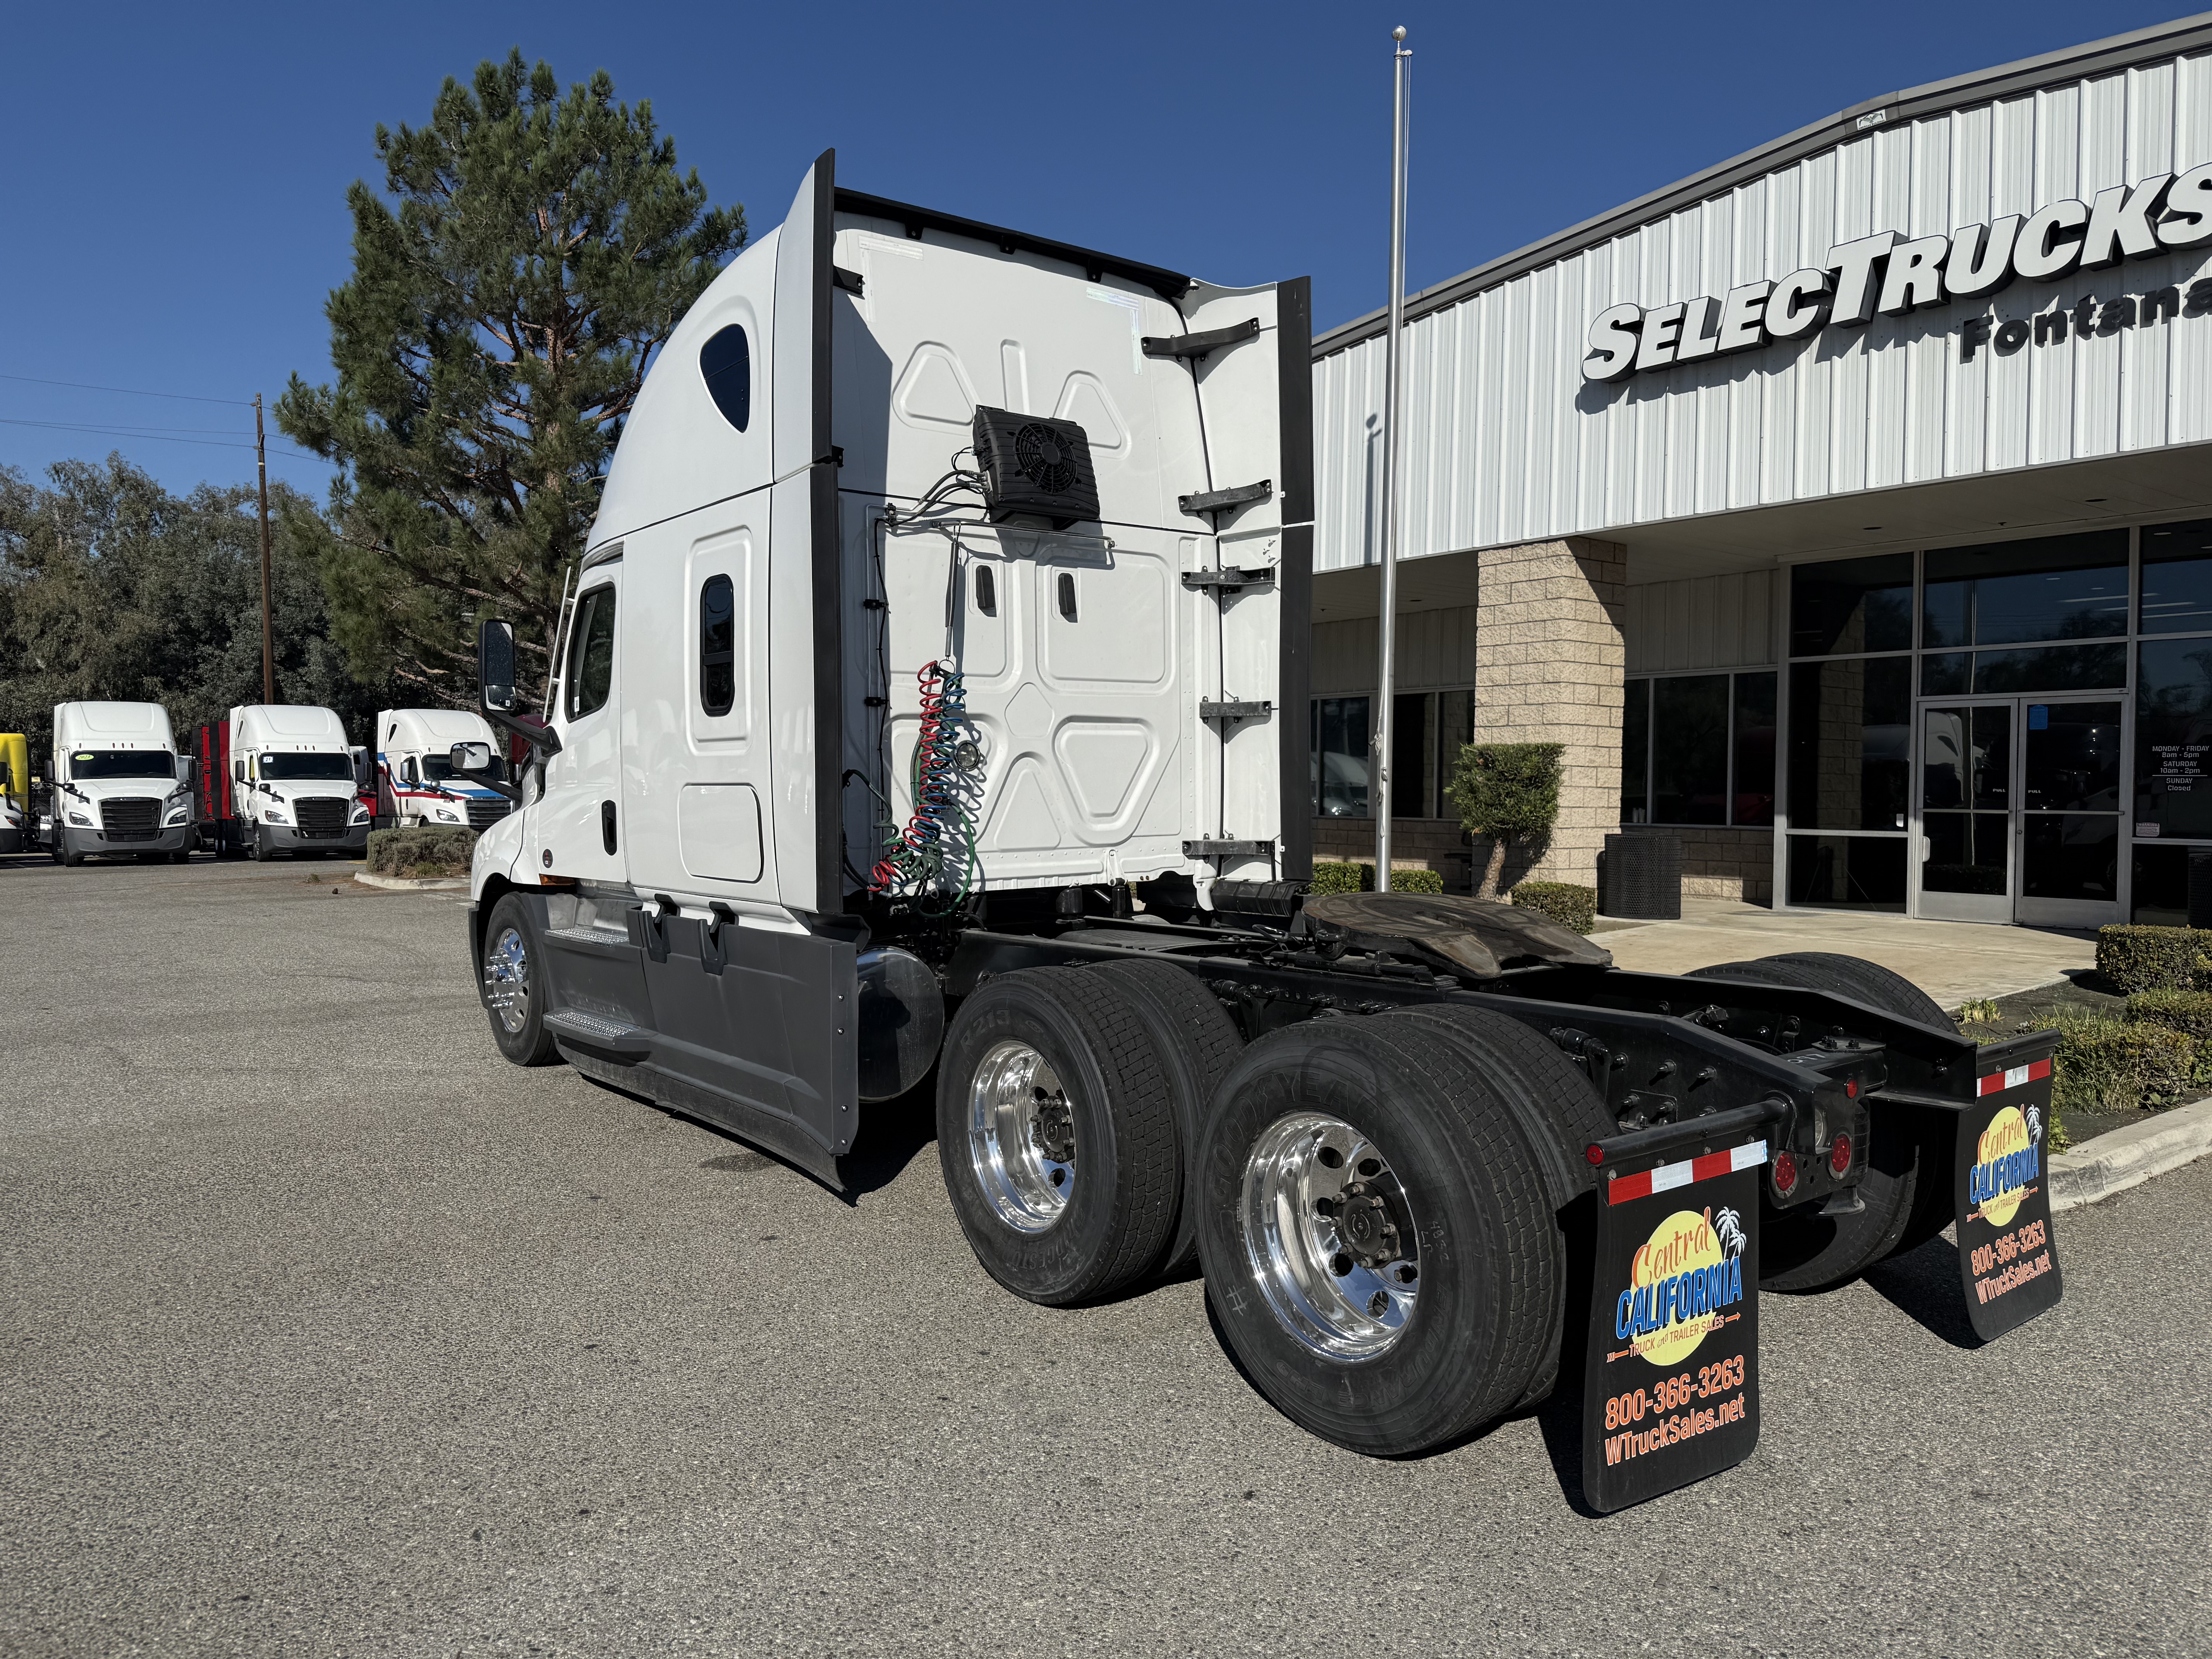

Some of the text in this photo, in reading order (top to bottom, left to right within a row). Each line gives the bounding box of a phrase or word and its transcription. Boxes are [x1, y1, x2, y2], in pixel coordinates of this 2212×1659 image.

[1582, 162, 2212, 383] SELECTRUCKS
[1963, 277, 2212, 357] Fontana
[1978, 1104, 2024, 1166] Central
[1970, 1143, 2039, 1204] CALIFORNIA
[1978, 1204, 1993, 1219] TRUCK
[2000, 1194, 2016, 1209] TRAILER
[2018, 1188, 2030, 1202] SALES
[1632, 1206, 1711, 1289] Central
[1971, 1219, 2046, 1276] 800-366-3263
[1975, 1249, 2052, 1305] WTruckSales.net
[1616, 1256, 1743, 1340] CALIFORNIA
[1630, 1315, 1724, 1357] TRUCK and TRAILER SALES
[1605, 1355, 1744, 1430] 800-366-3263
[1605, 1392, 1745, 1466] WTruckSales.net
